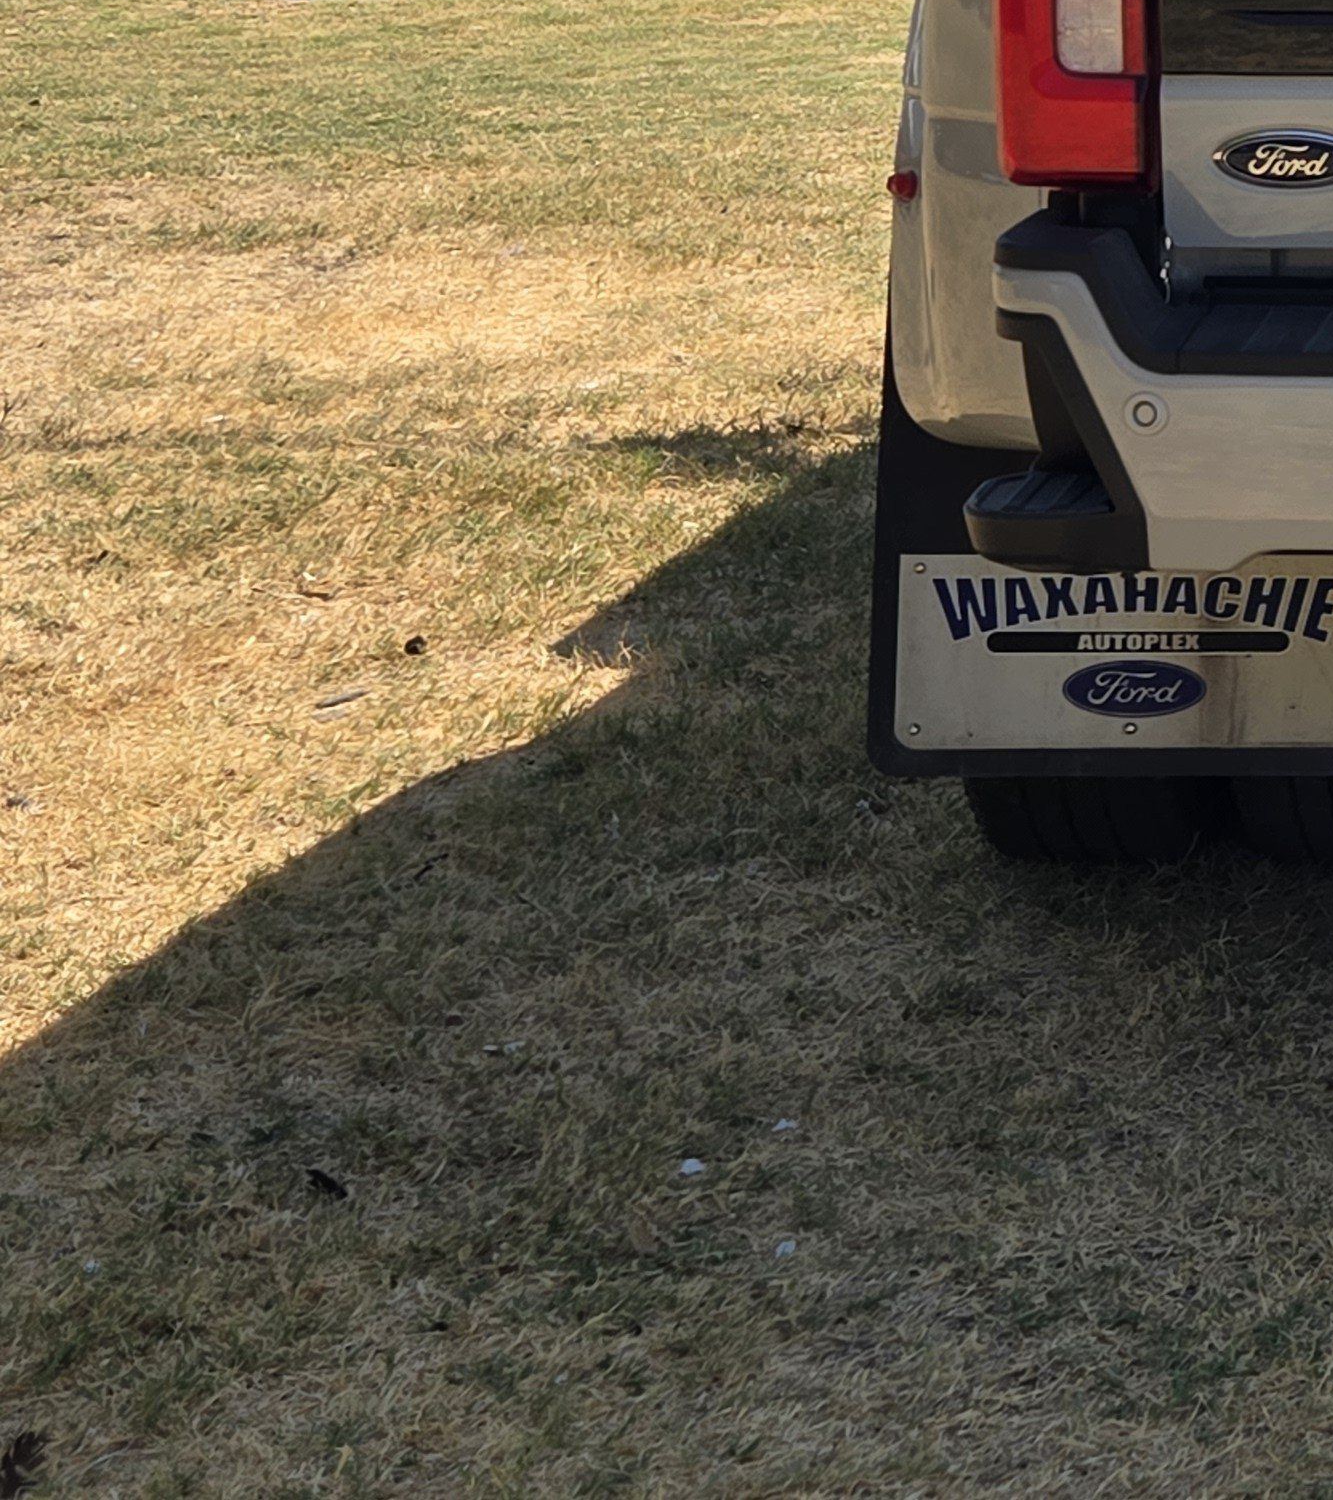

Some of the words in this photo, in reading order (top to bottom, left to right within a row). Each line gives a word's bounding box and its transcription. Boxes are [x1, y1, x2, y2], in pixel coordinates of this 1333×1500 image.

[1247, 142, 1330, 177] Ford
[1076, 632, 1201, 652] AUTOPLEX
[1086, 670, 1184, 706] Ford
